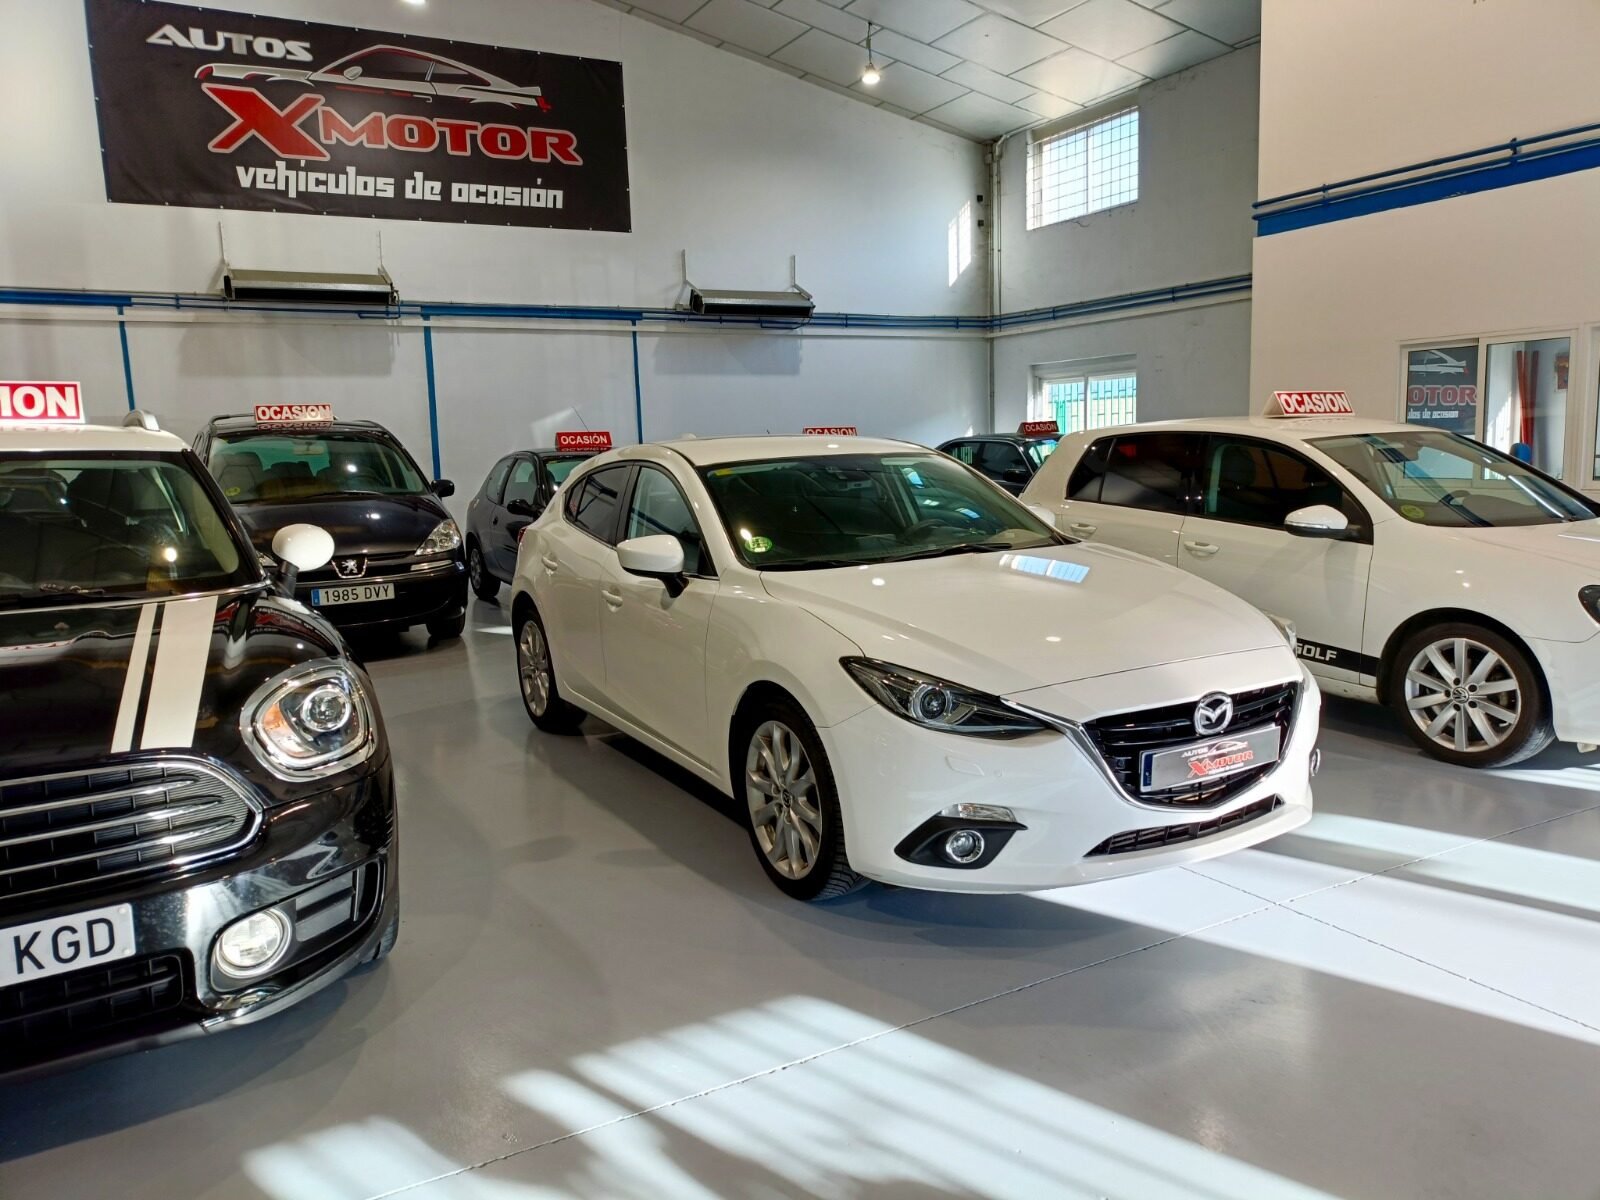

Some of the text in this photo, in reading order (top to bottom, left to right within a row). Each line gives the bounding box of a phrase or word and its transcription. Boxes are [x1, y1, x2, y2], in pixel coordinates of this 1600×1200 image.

[146, 24, 313, 62] AUTOS
[235, 160, 564, 209] vehículos de ocasión
[257, 406, 331, 420] OCASION
[1280, 393, 1352, 413] OCASION
[324, 585, 389, 603] 1985 DVY
[13, 917, 116, 975] KGD
